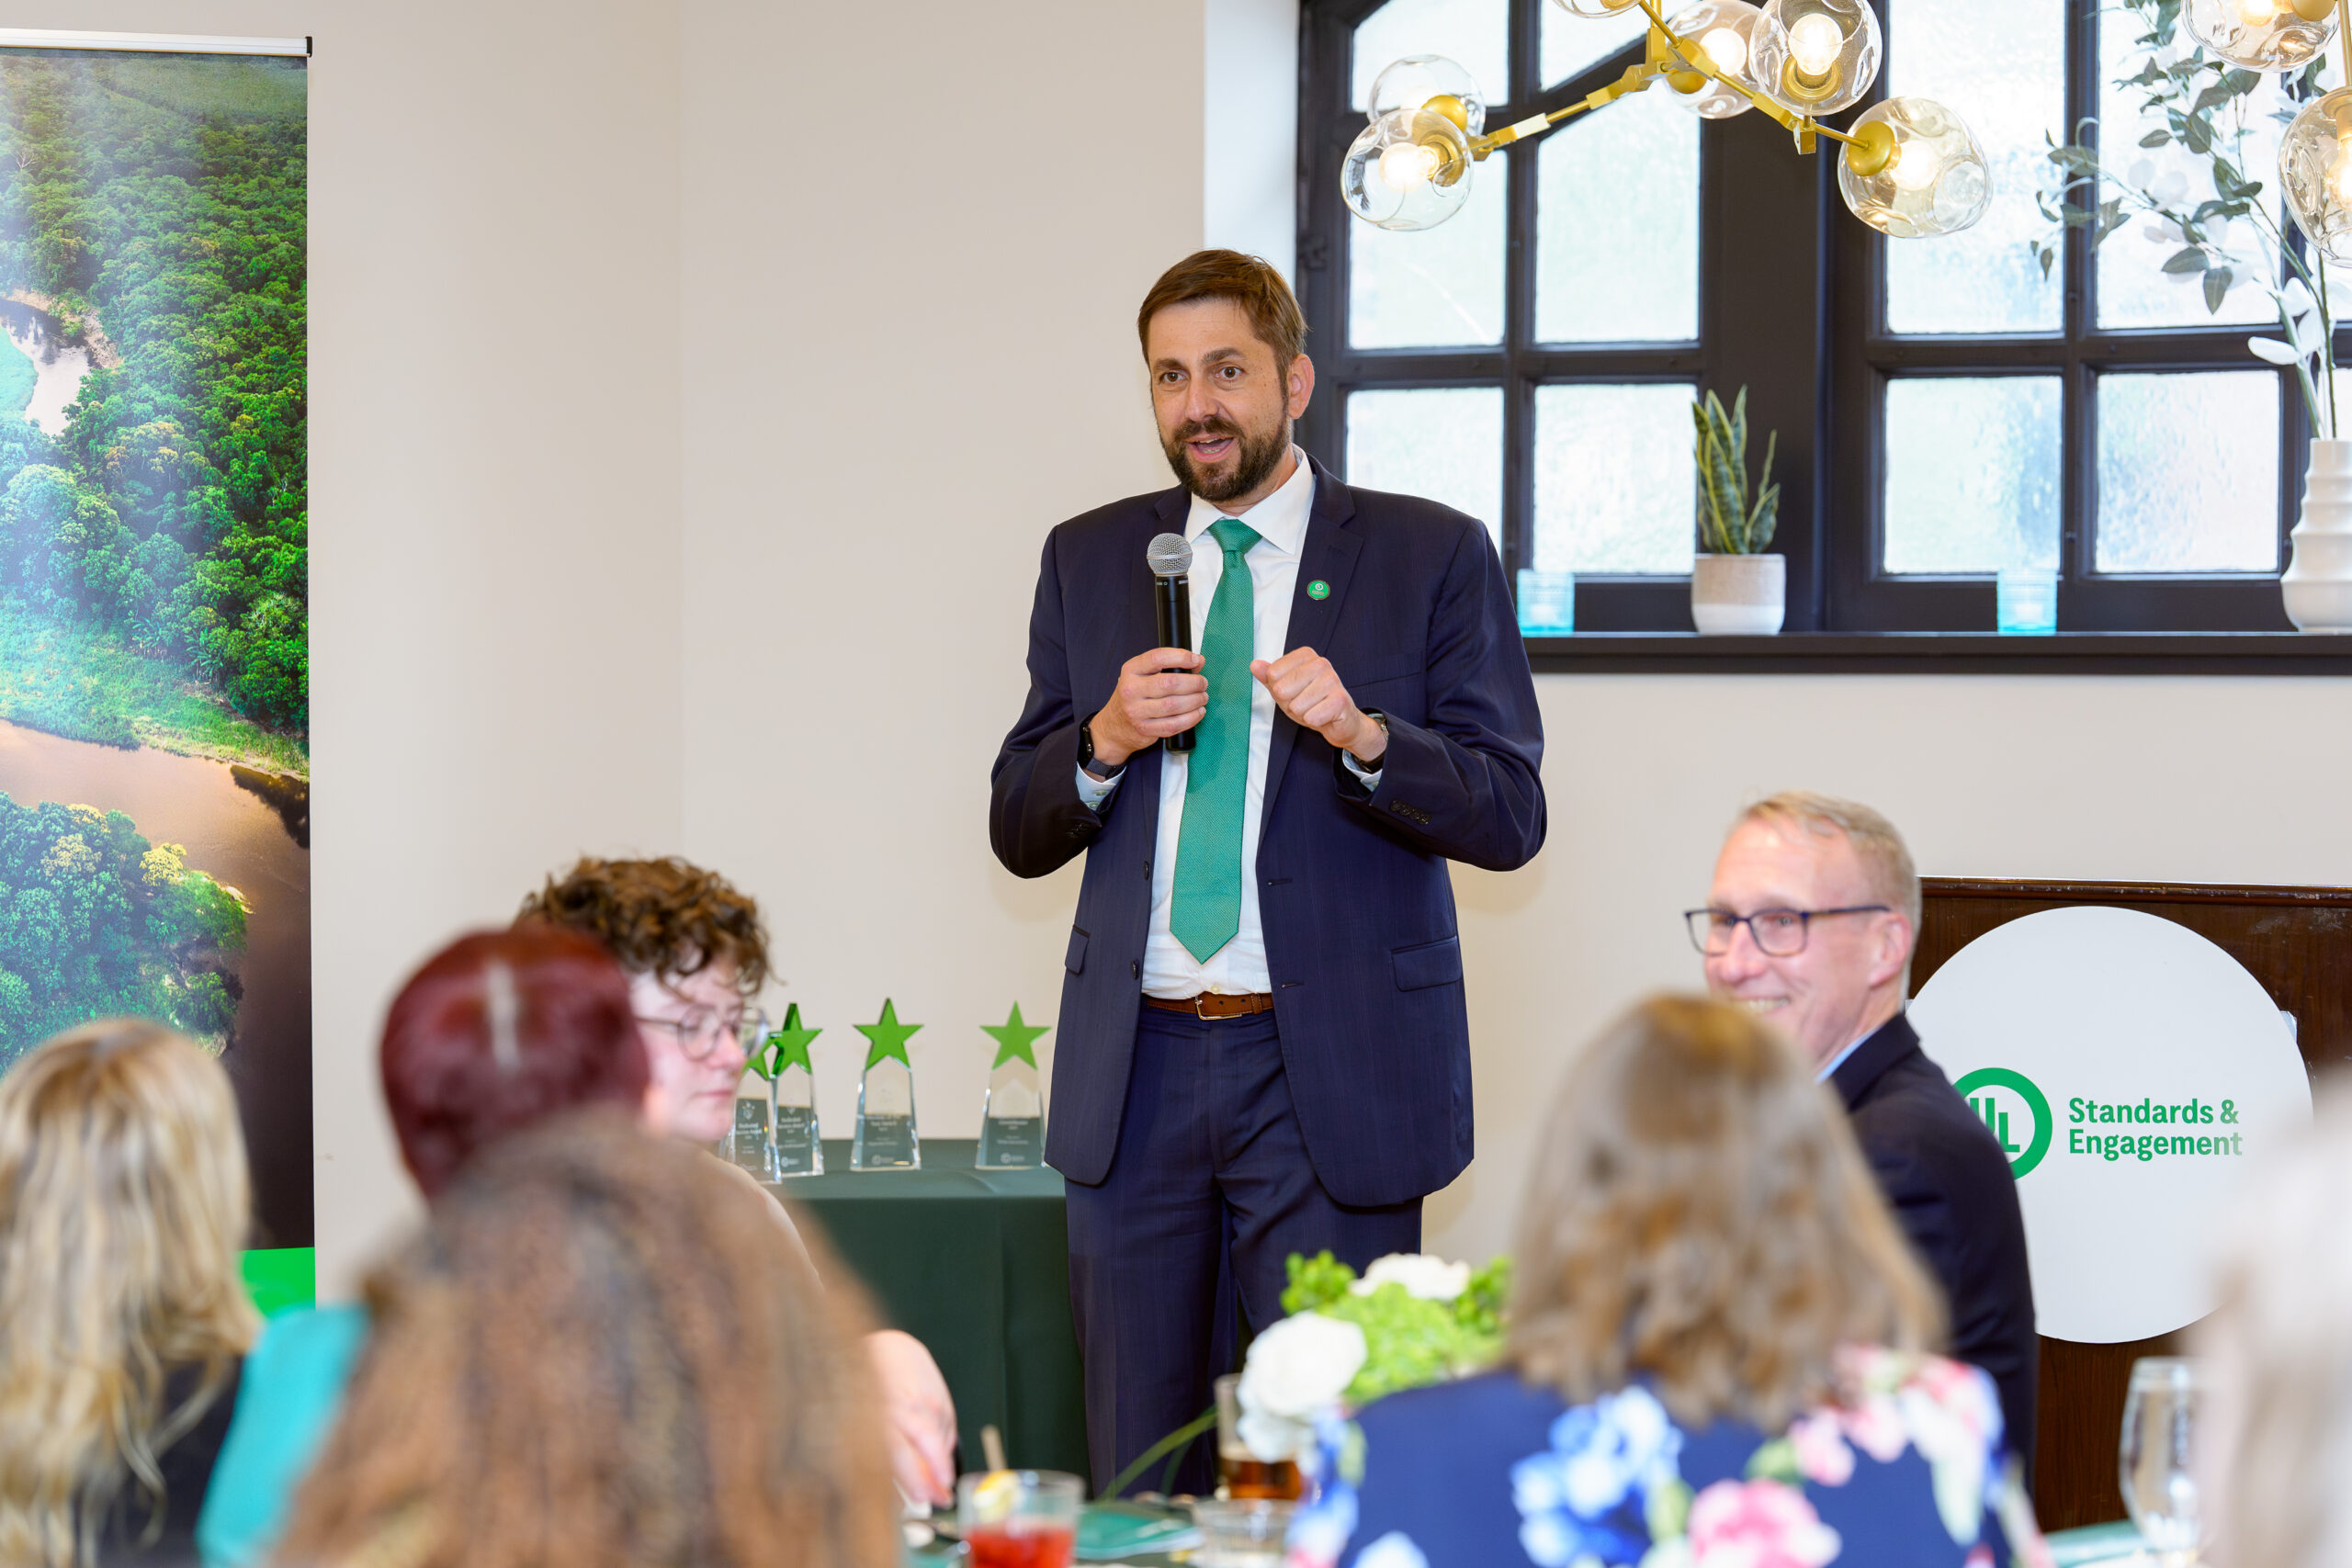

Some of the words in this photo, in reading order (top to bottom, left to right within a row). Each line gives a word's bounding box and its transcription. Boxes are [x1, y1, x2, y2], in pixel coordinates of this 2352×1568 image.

[2069, 1097, 2214, 1124] Standards
[2220, 1099, 2238, 1124] &
[2069, 1128, 2242, 1161] Engagement
